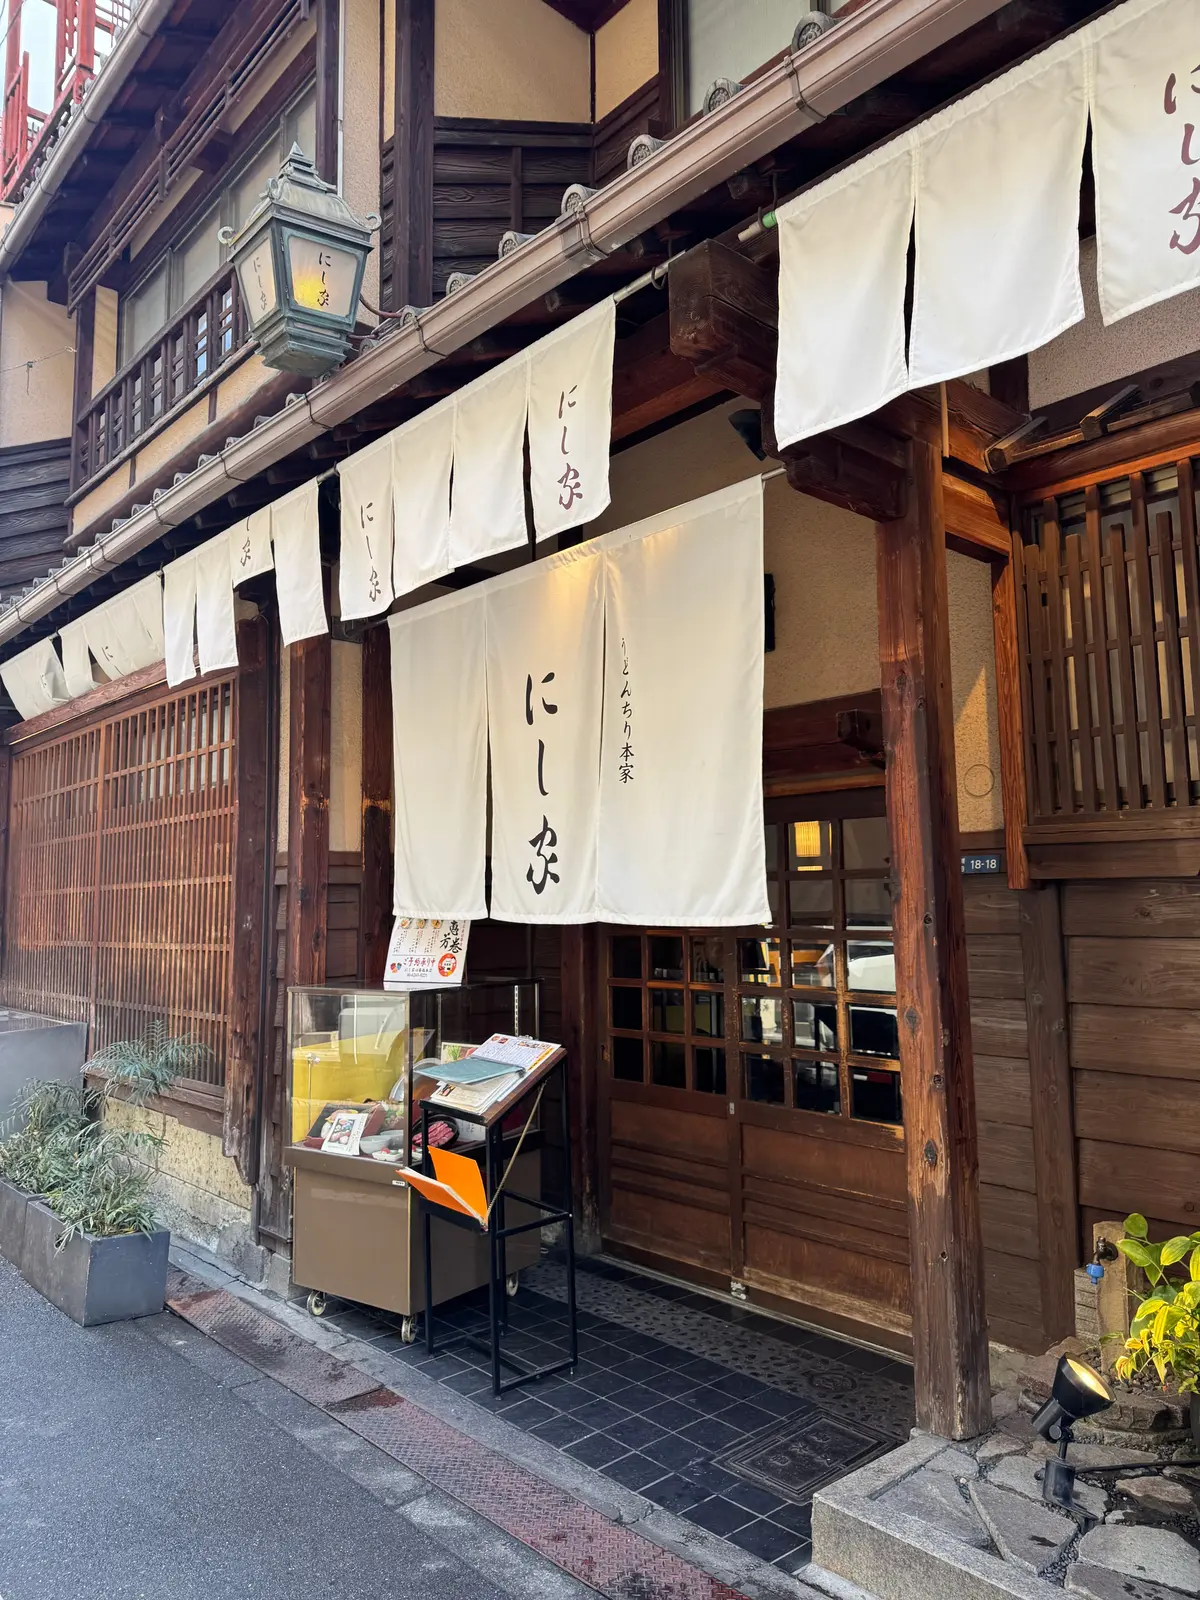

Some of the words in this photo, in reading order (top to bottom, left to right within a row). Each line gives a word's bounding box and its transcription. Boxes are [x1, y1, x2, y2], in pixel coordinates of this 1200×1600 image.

[316, 251, 334, 307] にし家
[557, 385, 583, 511] にし家
[360, 501, 383, 603] にし家
[619, 637, 635, 784] うどんちり本家
[526, 672, 560, 895] にし家
[970, 859, 997, 870] 18-18
